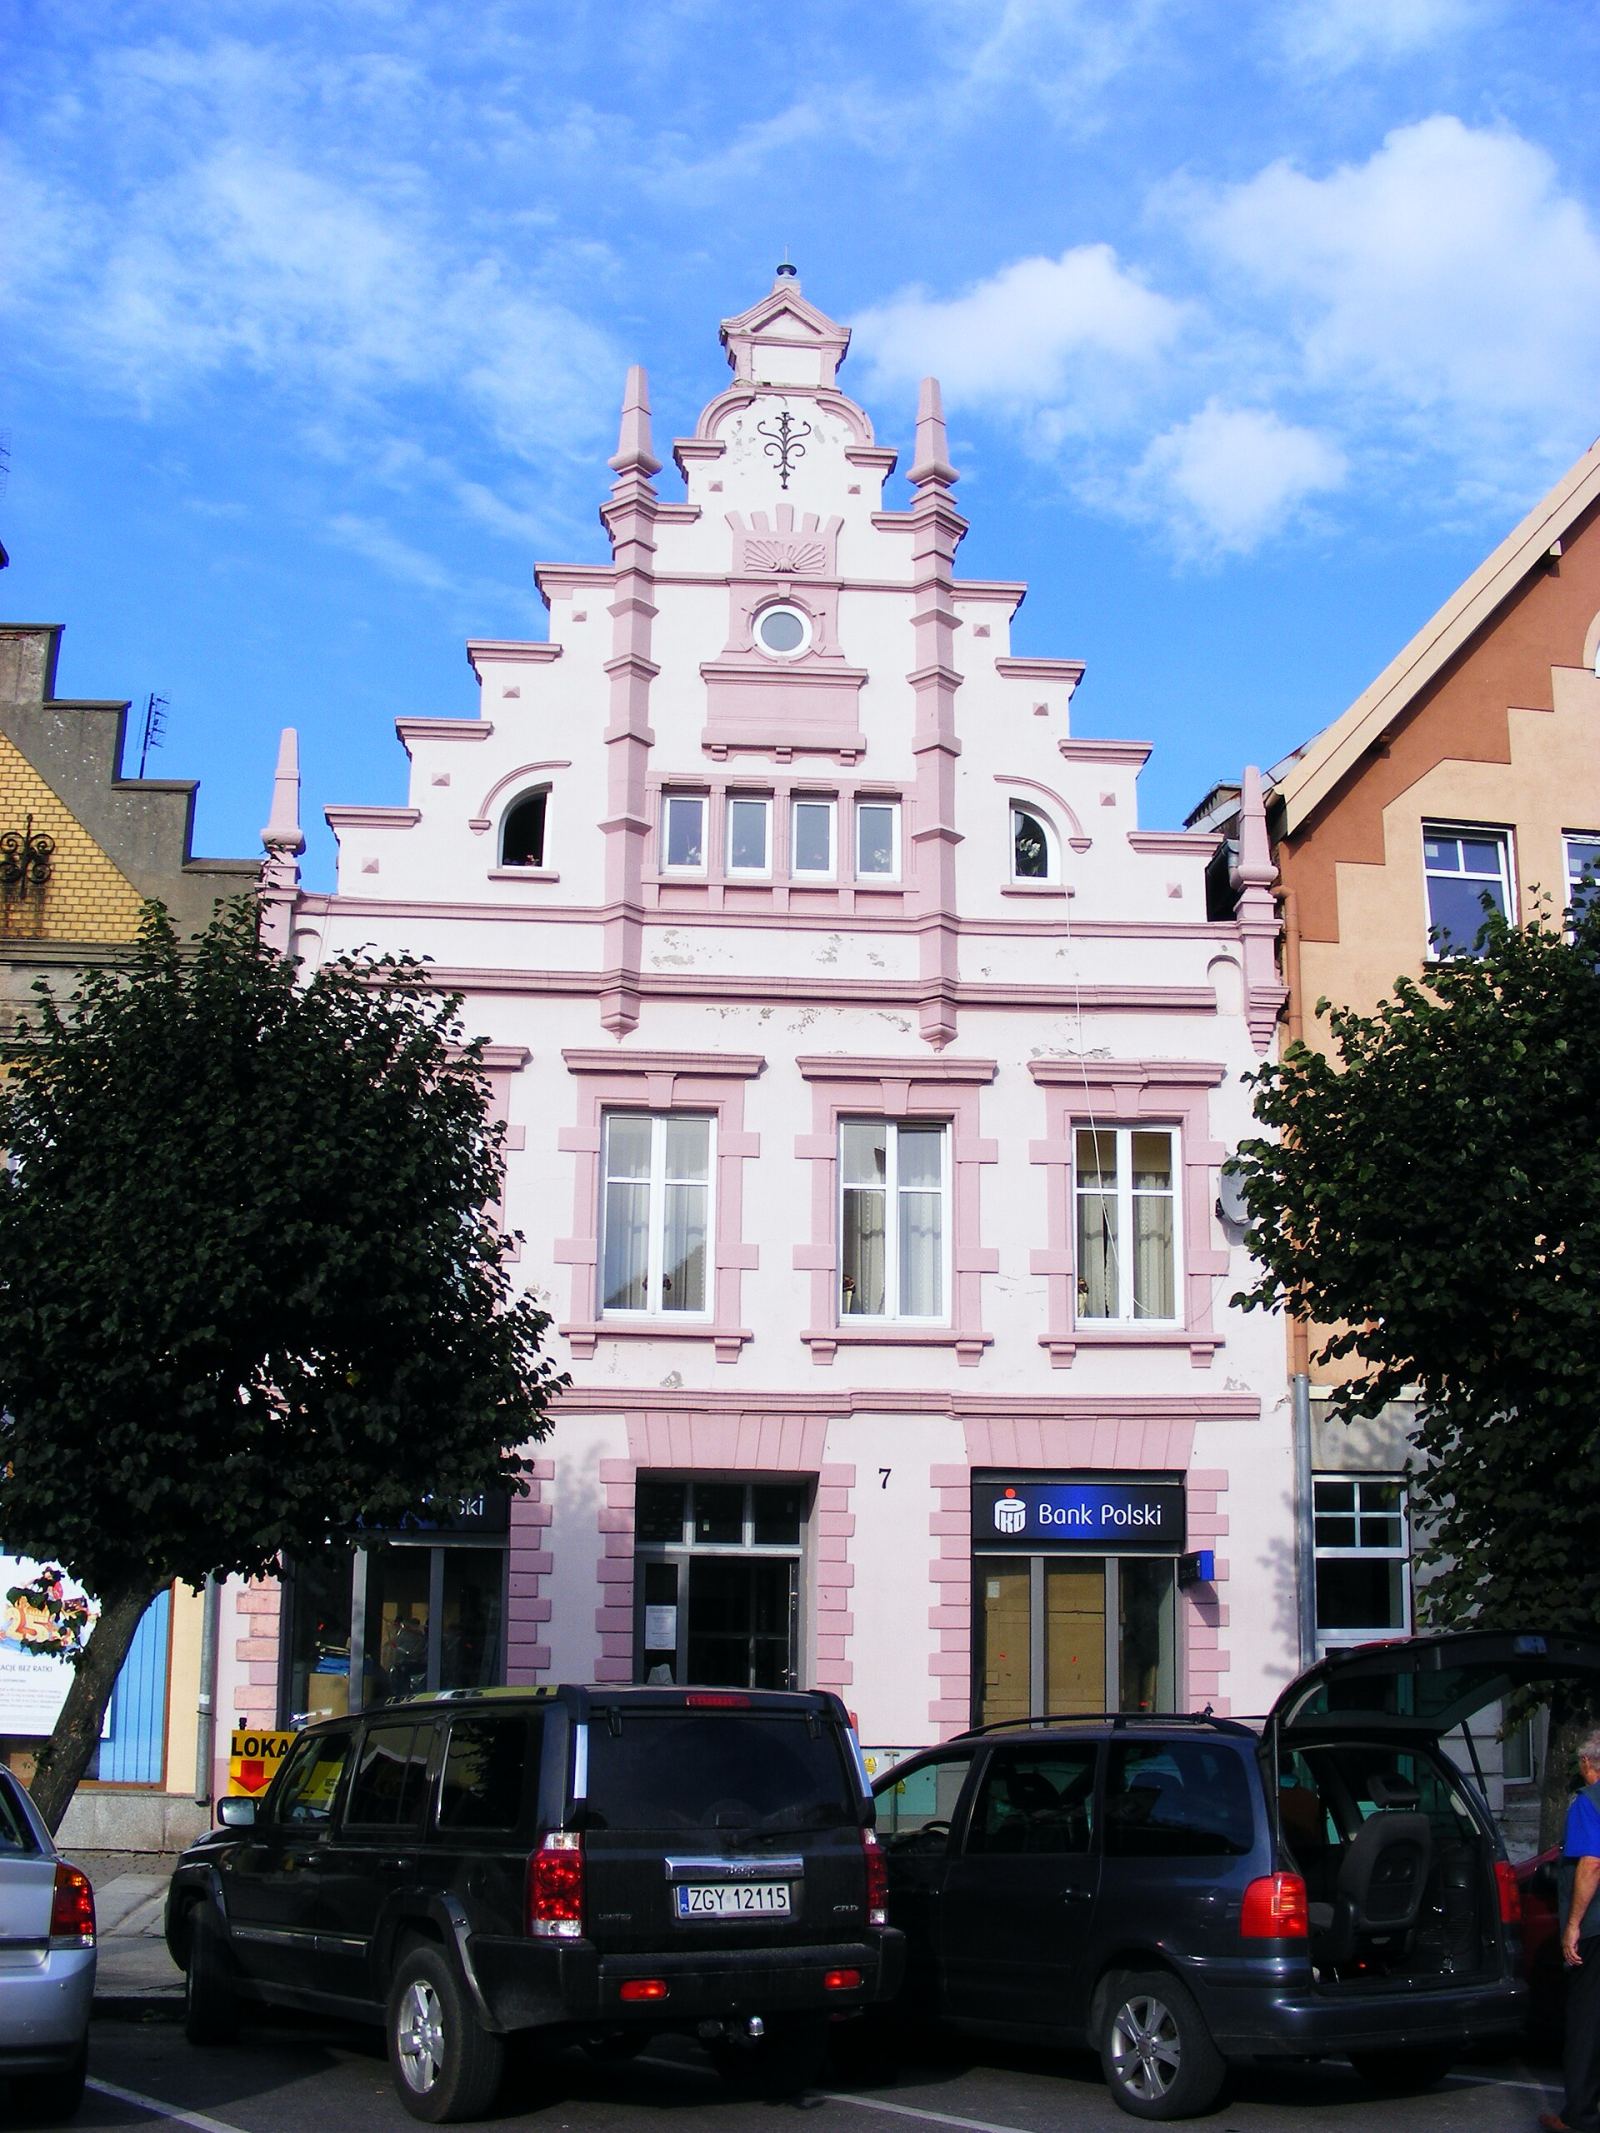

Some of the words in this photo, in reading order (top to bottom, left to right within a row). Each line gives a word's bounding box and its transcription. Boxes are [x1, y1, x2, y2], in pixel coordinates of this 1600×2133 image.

[879, 1467, 892, 1490] 7
[1039, 1503, 1093, 1525] Bank
[1101, 1503, 1162, 1526] Polski
[690, 1888, 725, 1911] ZGY
[733, 1887, 787, 1910] 12115
